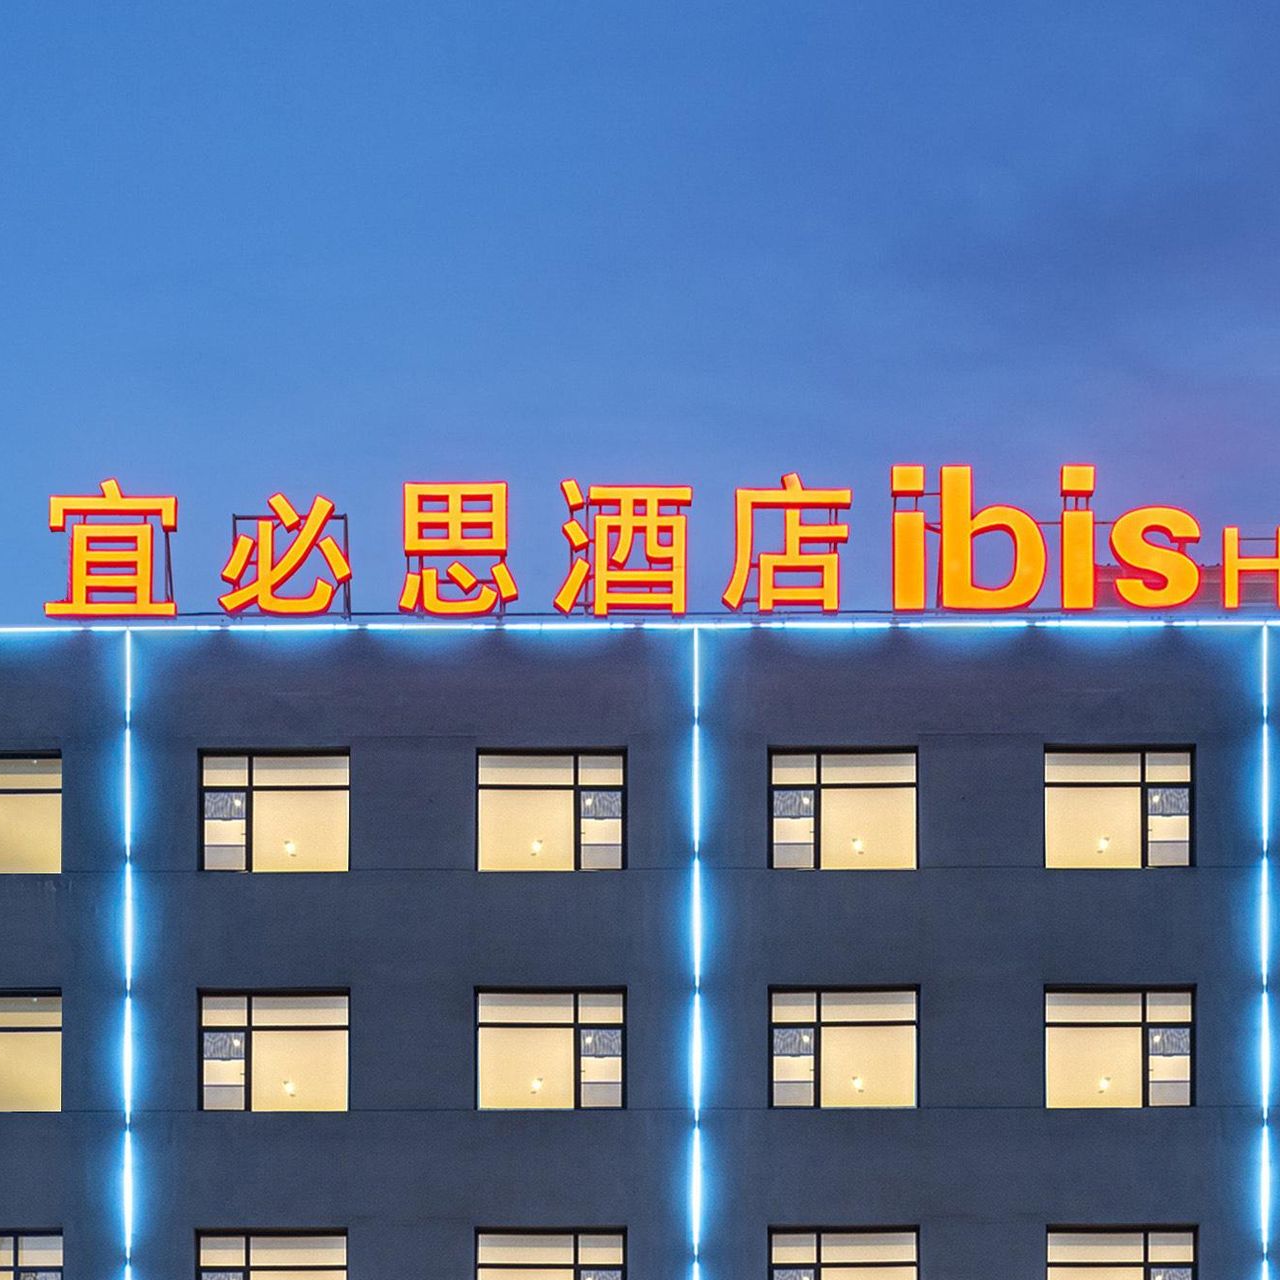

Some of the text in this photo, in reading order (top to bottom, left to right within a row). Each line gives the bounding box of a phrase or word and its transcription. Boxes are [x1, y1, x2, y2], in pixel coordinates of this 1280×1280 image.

[44, 472, 852, 617] 宜必思酒店
[891, 463, 1201, 612] ibis
